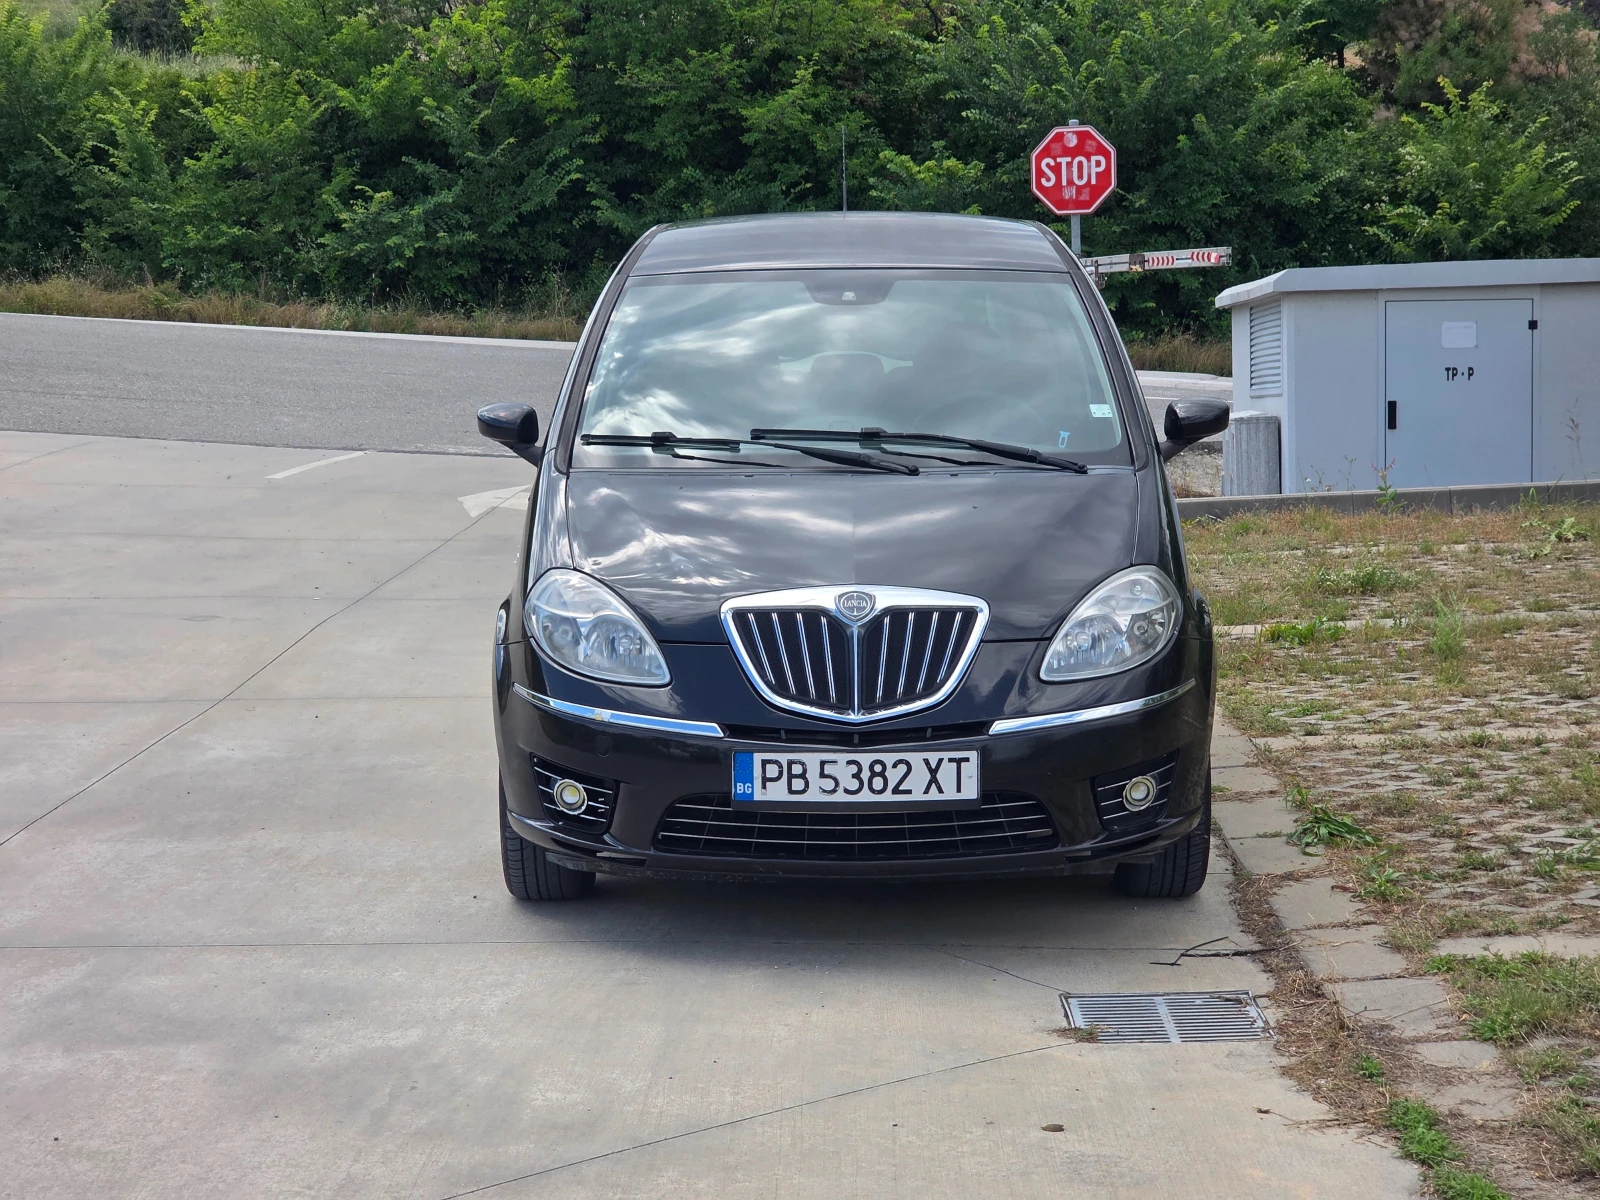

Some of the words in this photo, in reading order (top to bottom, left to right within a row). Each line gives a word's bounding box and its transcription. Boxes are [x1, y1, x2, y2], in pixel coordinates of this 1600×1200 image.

[1041, 155, 1106, 187] STOP
[844, 599, 867, 607] LANCIA
[736, 782, 753, 794] BG
